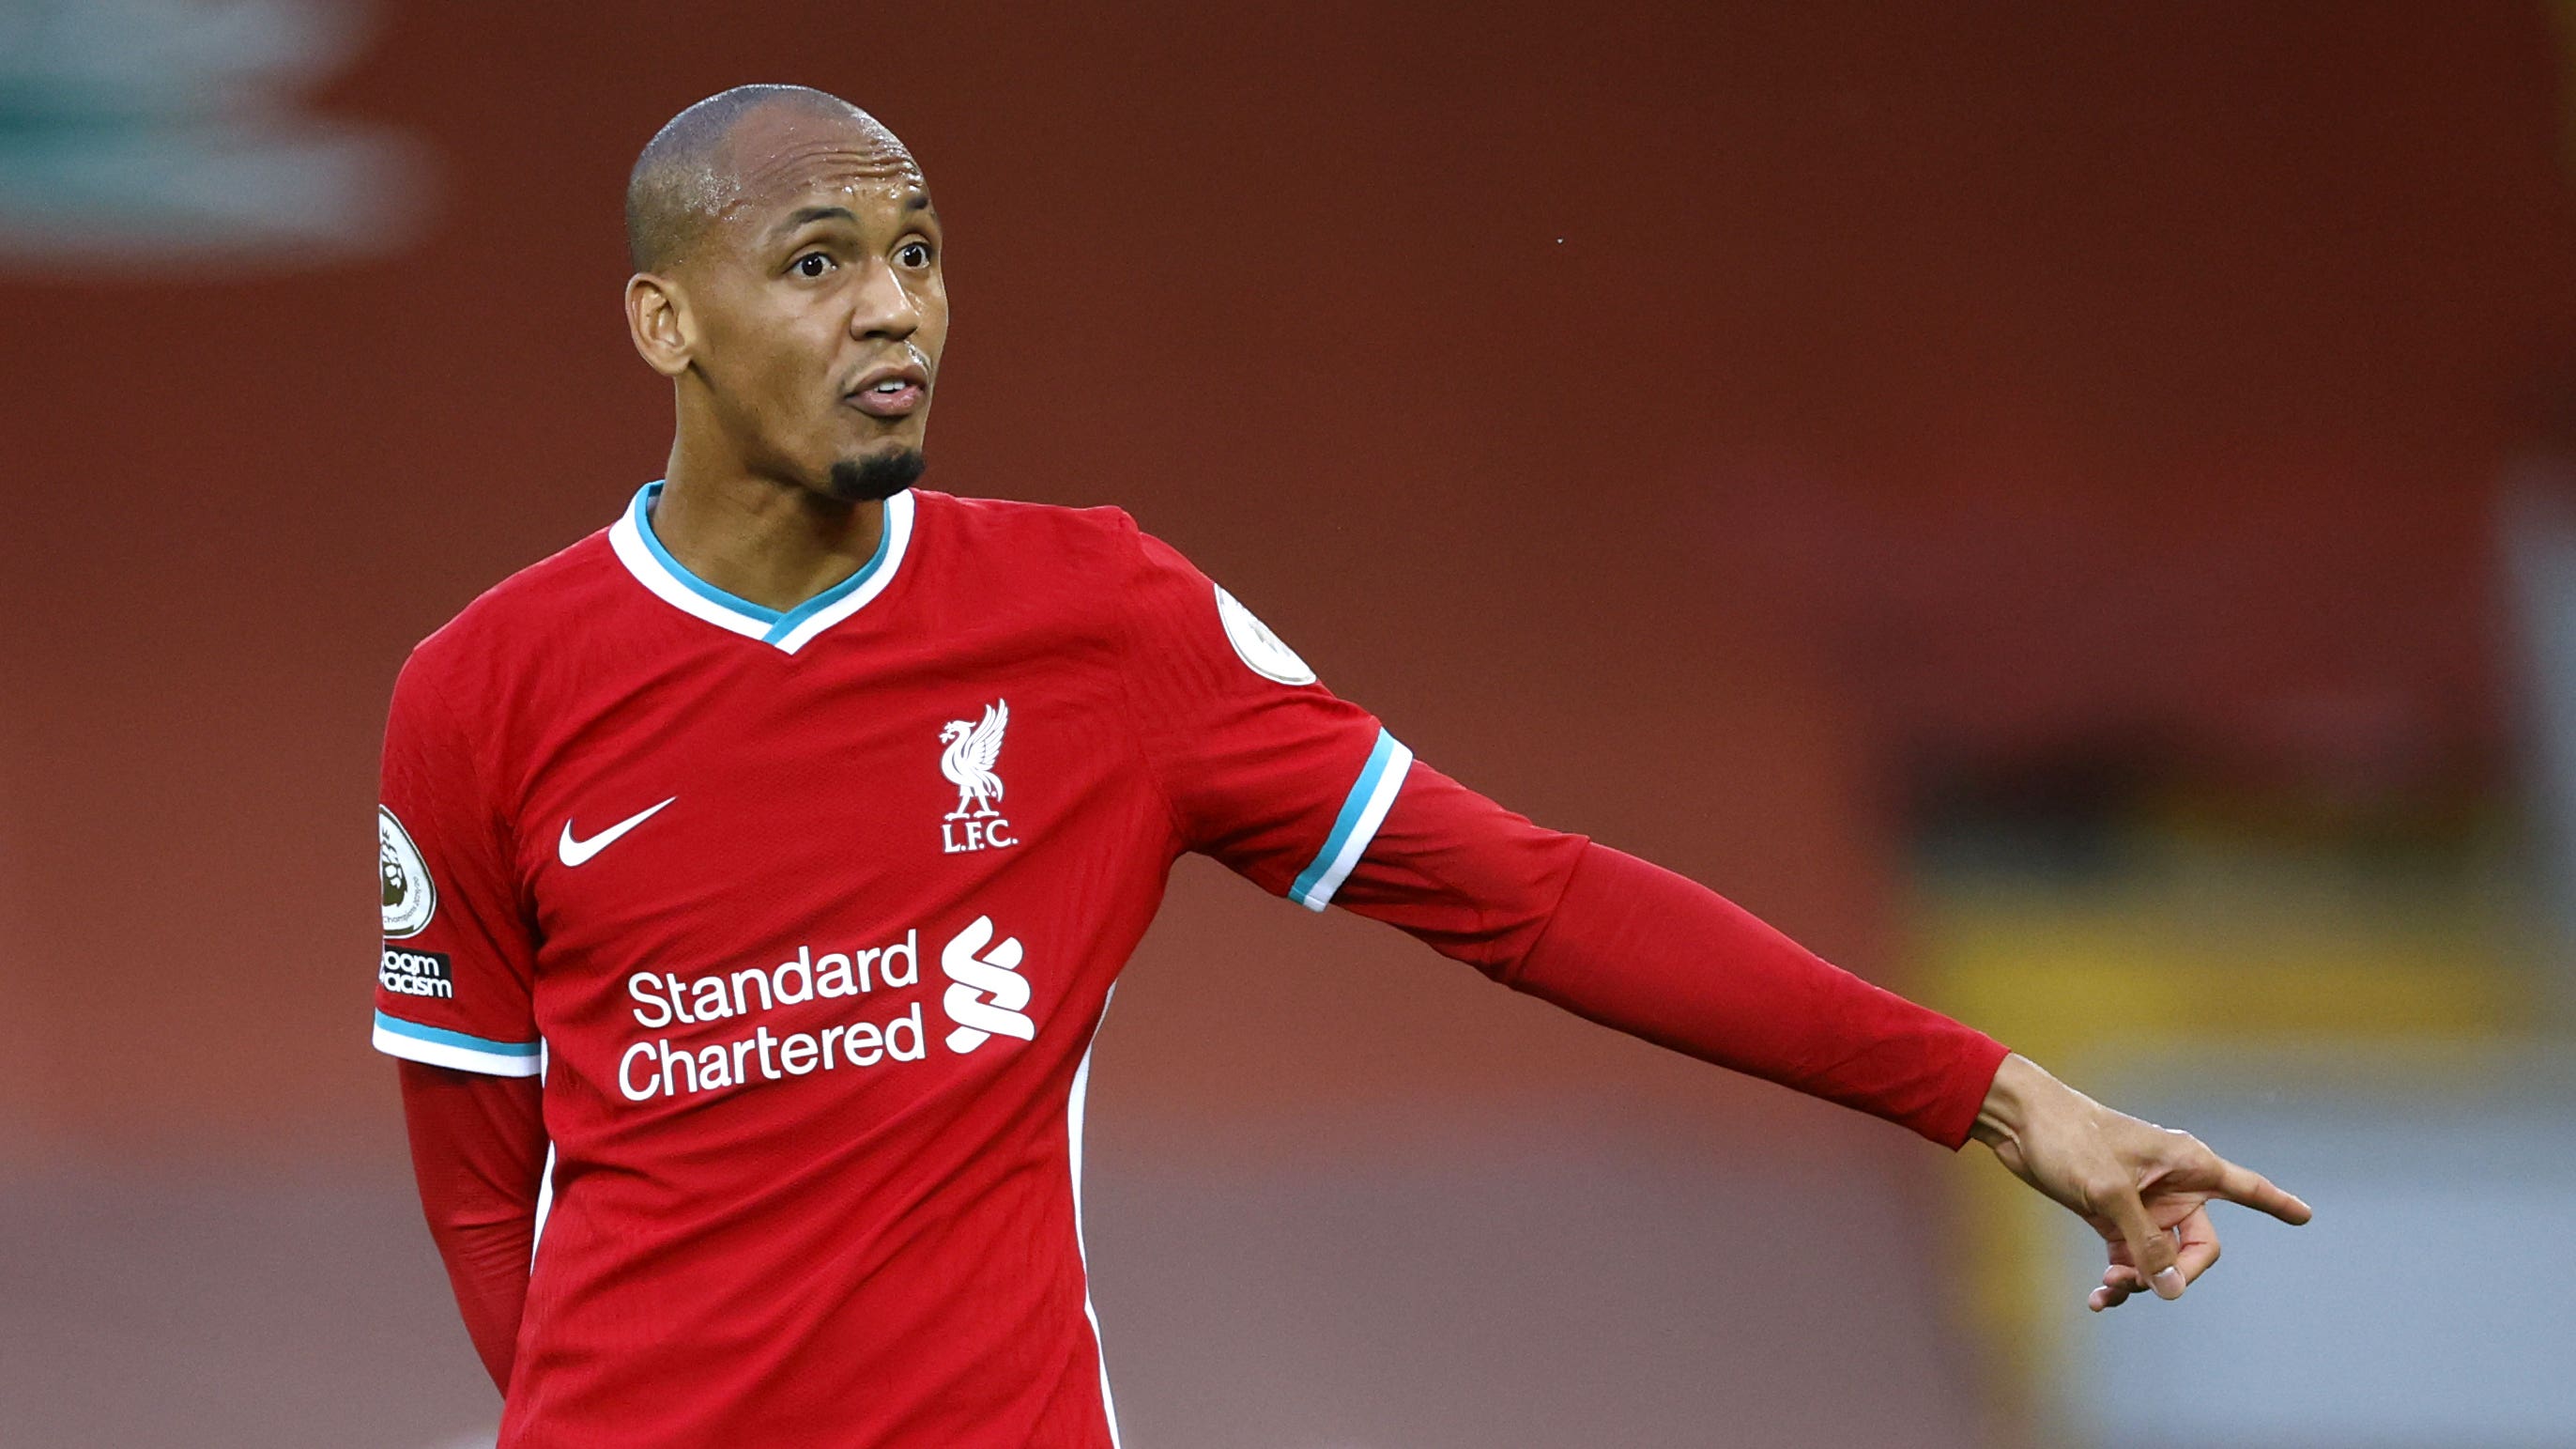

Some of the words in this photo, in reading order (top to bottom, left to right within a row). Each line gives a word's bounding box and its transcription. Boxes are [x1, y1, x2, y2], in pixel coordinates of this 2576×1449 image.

[383, 950, 439, 977] oom
[628, 928, 919, 1028] Standard
[618, 1001, 926, 1102] Chartered
